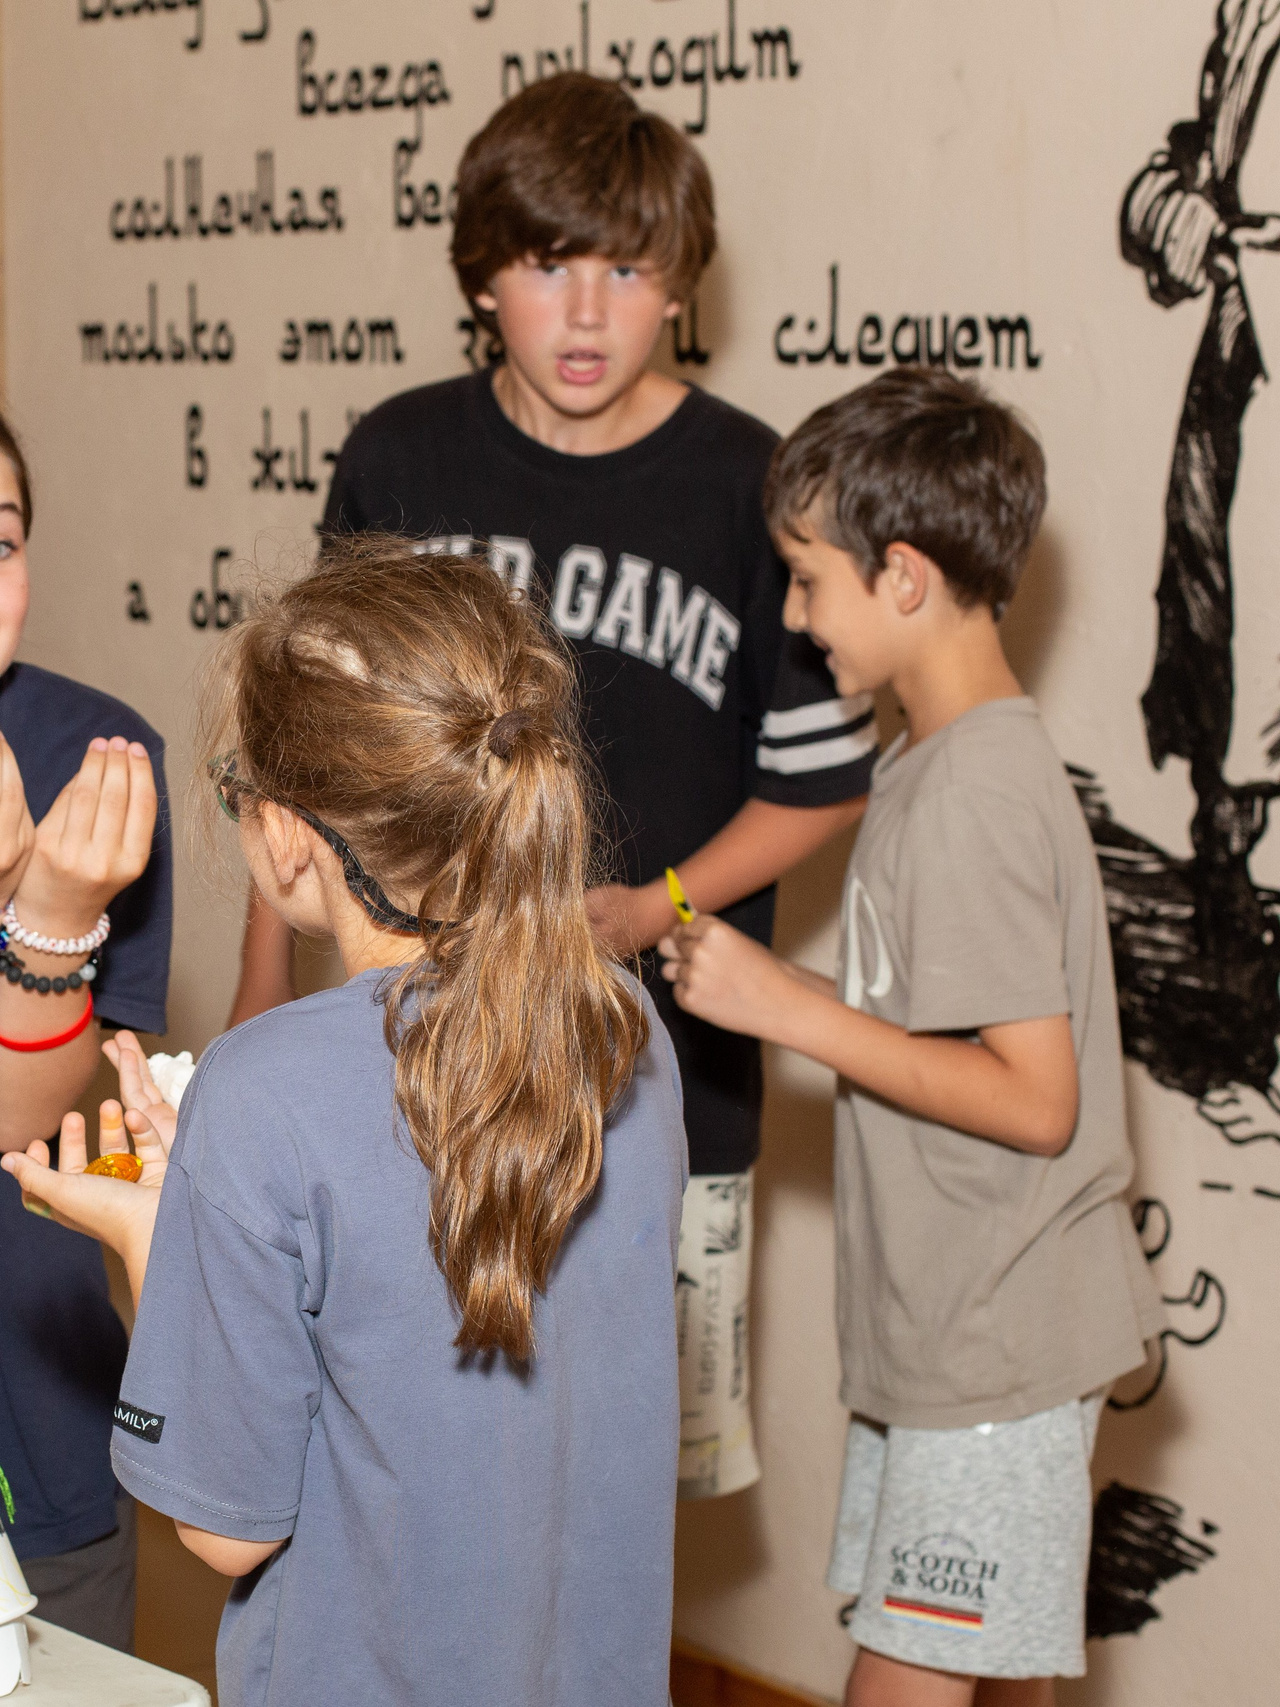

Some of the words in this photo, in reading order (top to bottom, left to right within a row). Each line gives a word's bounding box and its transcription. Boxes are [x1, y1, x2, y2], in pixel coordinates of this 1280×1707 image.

[80, 282, 236, 362] только
[280, 318, 404, 363] этот
[773, 262, 1041, 369] следует
[188, 404, 209, 490] в
[128, 579, 150, 623] а
[550, 542, 742, 713] GAME
[890, 1545, 999, 1581] SCOTCH
[892, 1567, 908, 1586] &
[917, 1572, 985, 1600] SODA
